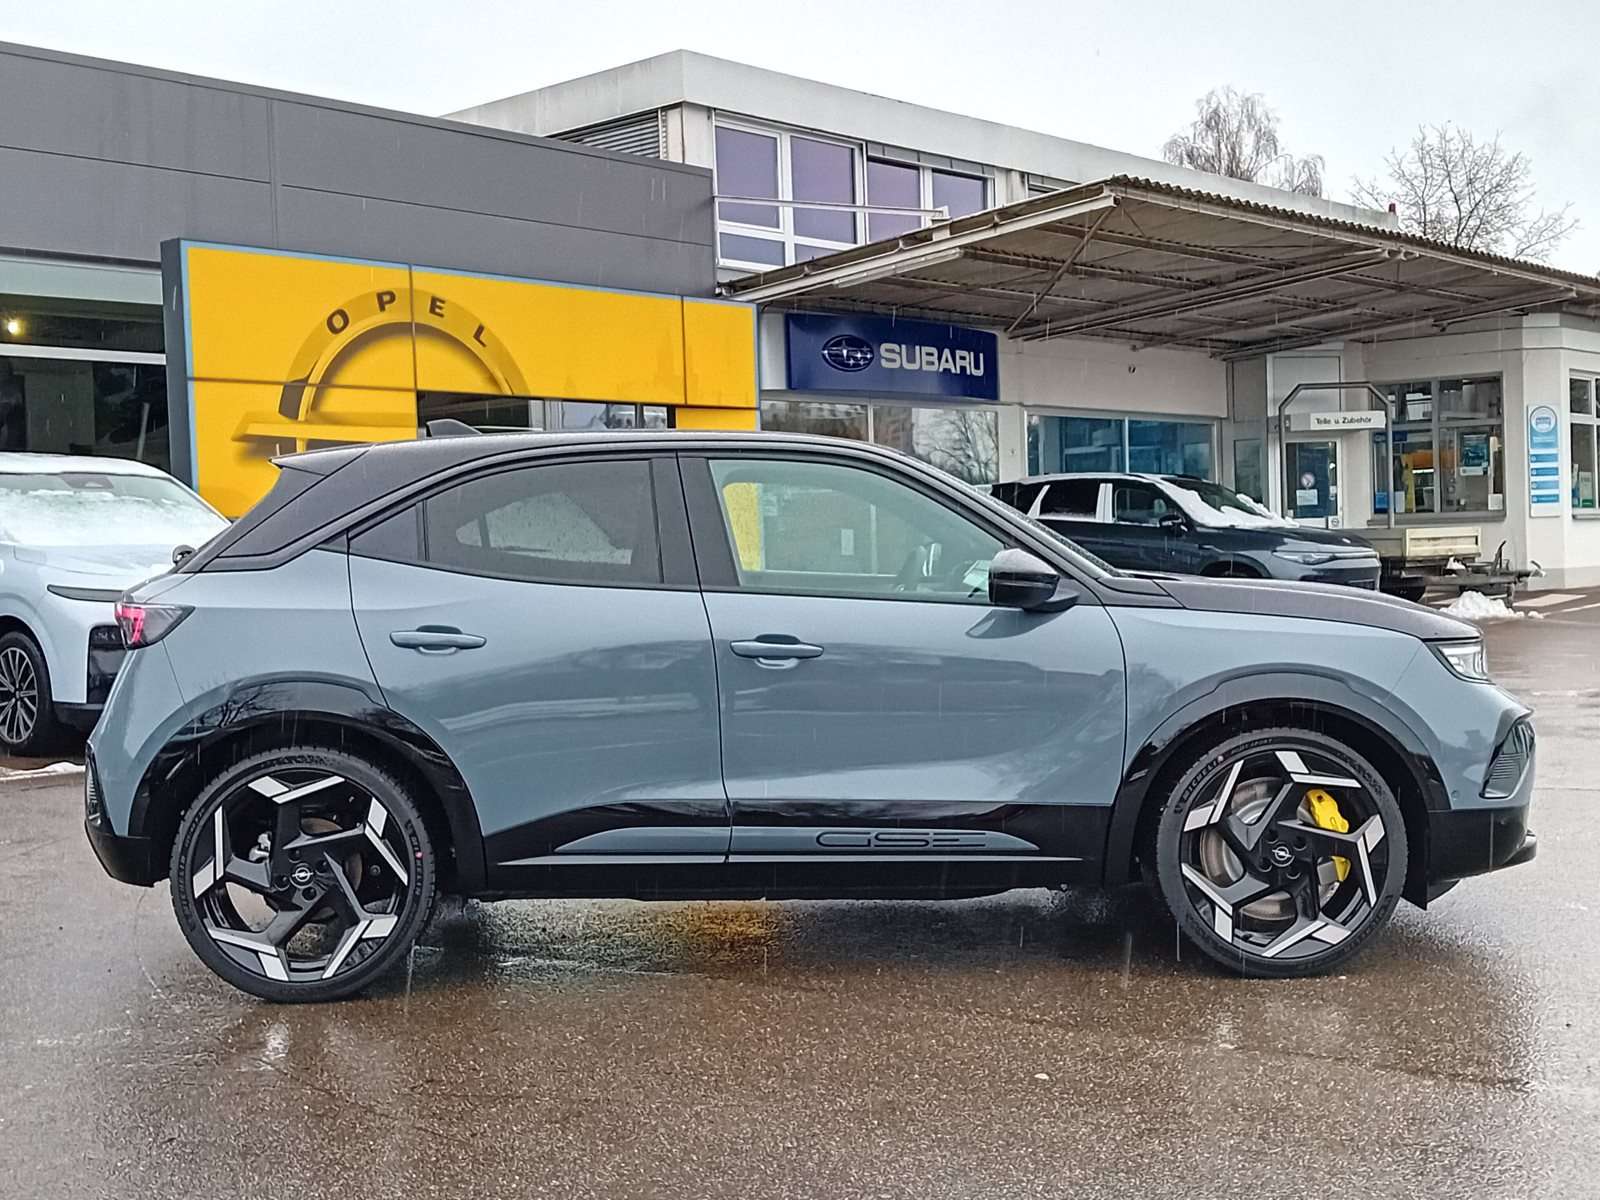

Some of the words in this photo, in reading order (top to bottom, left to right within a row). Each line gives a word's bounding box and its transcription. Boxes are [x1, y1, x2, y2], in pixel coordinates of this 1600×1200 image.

[326, 290, 487, 348] OPEL
[880, 342, 984, 376] SUBARU
[816, 831, 986, 848] GSE
